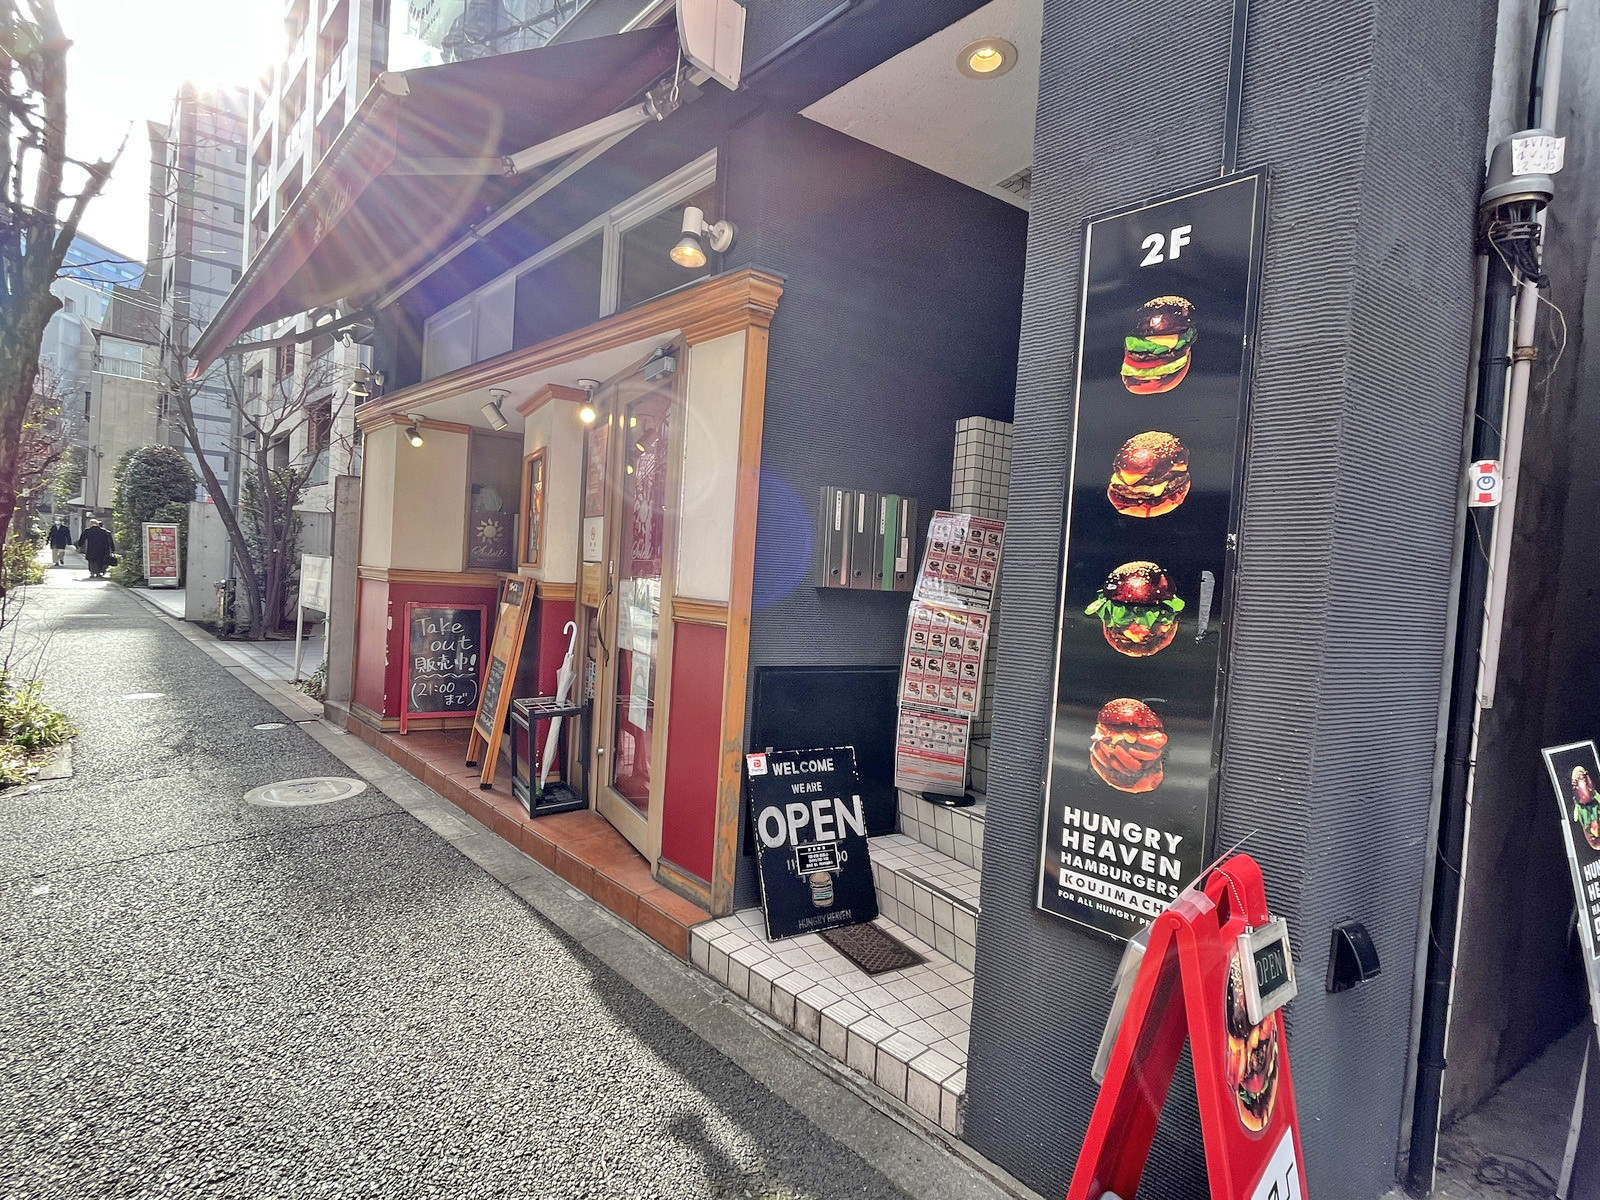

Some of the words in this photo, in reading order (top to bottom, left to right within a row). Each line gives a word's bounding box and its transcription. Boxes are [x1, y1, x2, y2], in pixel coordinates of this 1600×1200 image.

[1140, 224, 1192, 267] 2F
[415, 617, 464, 636] Take
[431, 635, 473, 652] out
[772, 758, 835, 776] WELCOME
[806, 781, 823, 792] ARE
[757, 795, 865, 848] OPEN
[1063, 805, 1183, 855] HUNGRY
[1061, 827, 1182, 881] HEAVEN
[1060, 851, 1179, 899] HAMBURGERS
[1063, 873, 1166, 915] KOUJIMACH
[1057, 889, 1075, 901] FOR
[1077, 896, 1094, 908] ALL
[1096, 902, 1136, 922] HUNGRY
[1255, 949, 1283, 987] OPEN
